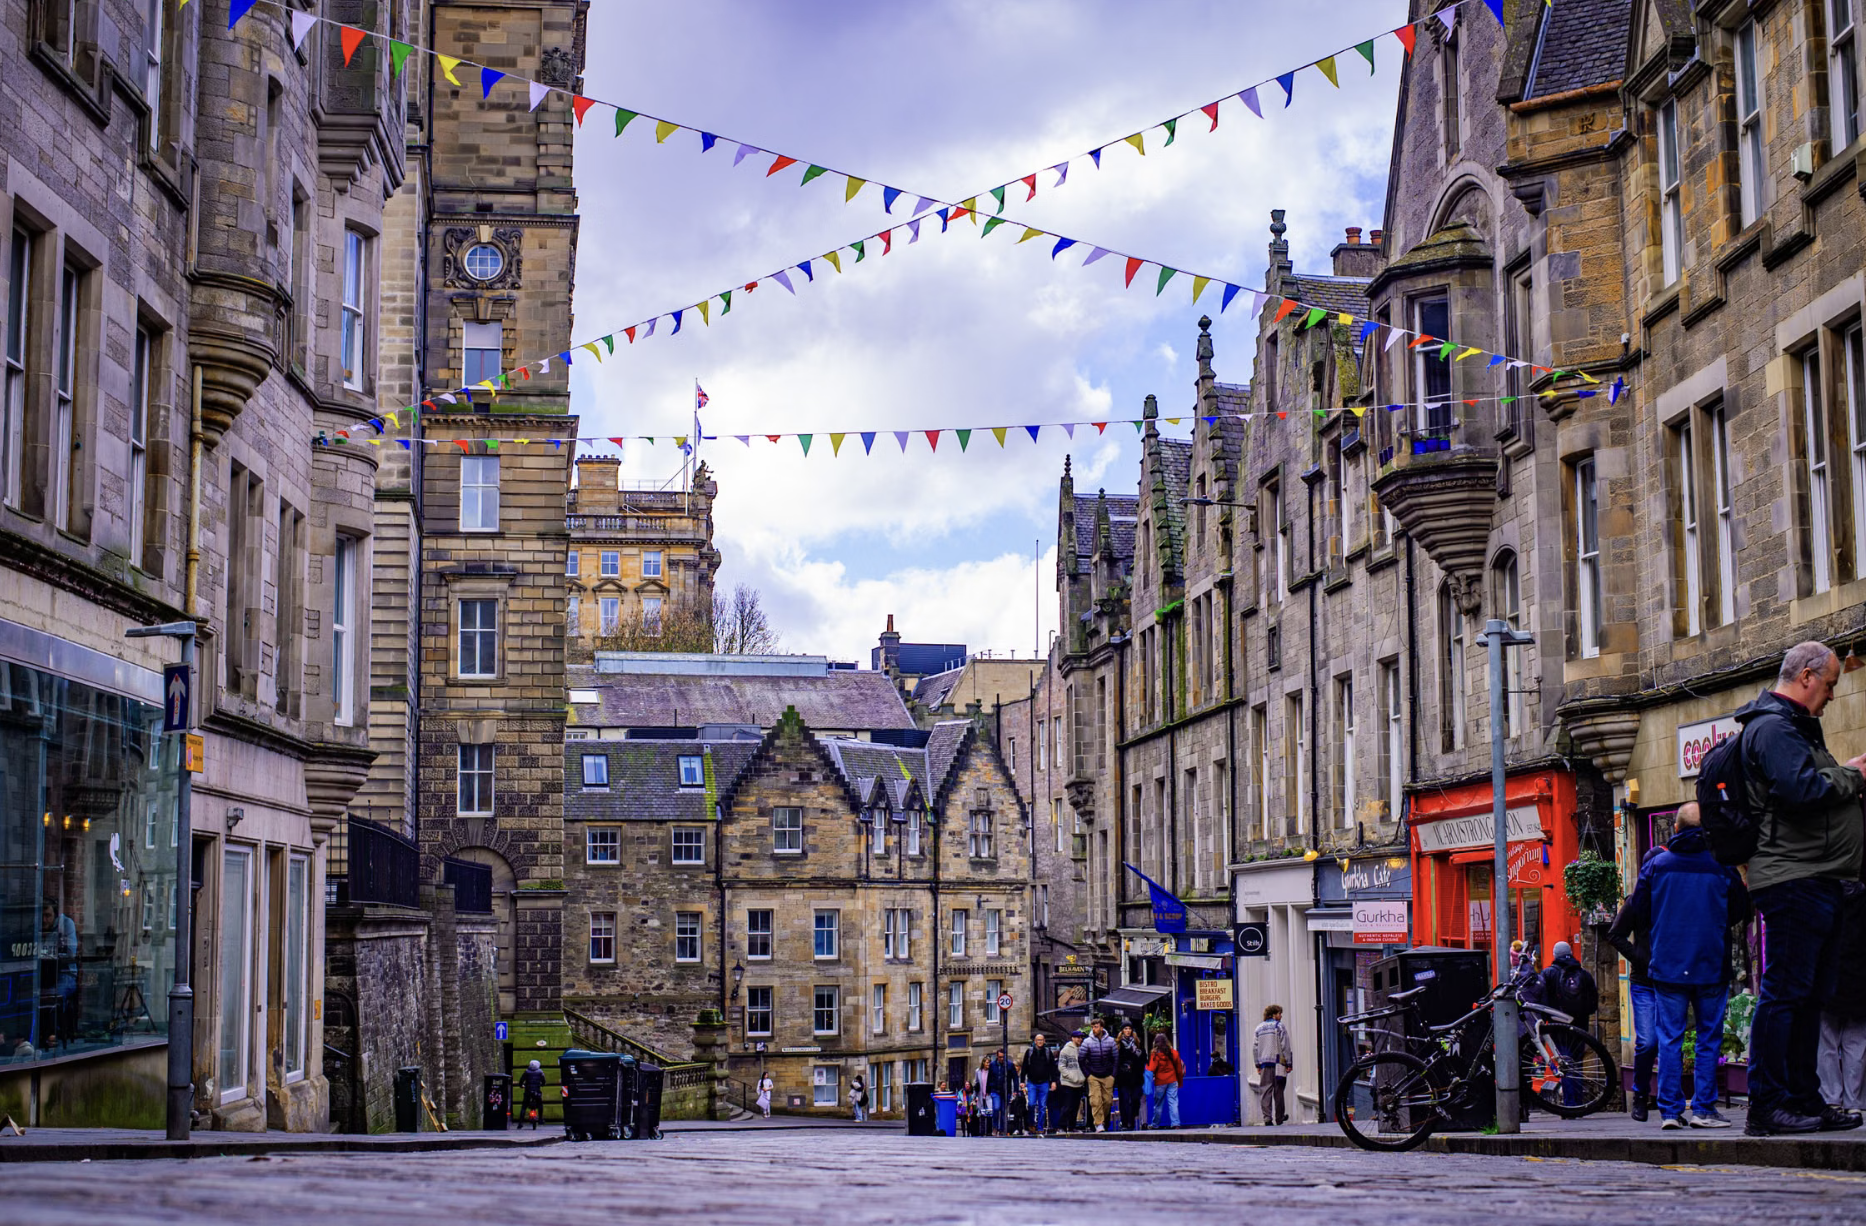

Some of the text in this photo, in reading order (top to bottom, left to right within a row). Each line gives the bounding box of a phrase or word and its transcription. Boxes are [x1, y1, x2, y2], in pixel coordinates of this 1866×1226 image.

[1443, 816, 1495, 845] ARMSTRONG
[1507, 847, 1541, 882] mporium
[1341, 864, 1369, 899] Gurkha
[1356, 910, 1405, 923] Gurkha
